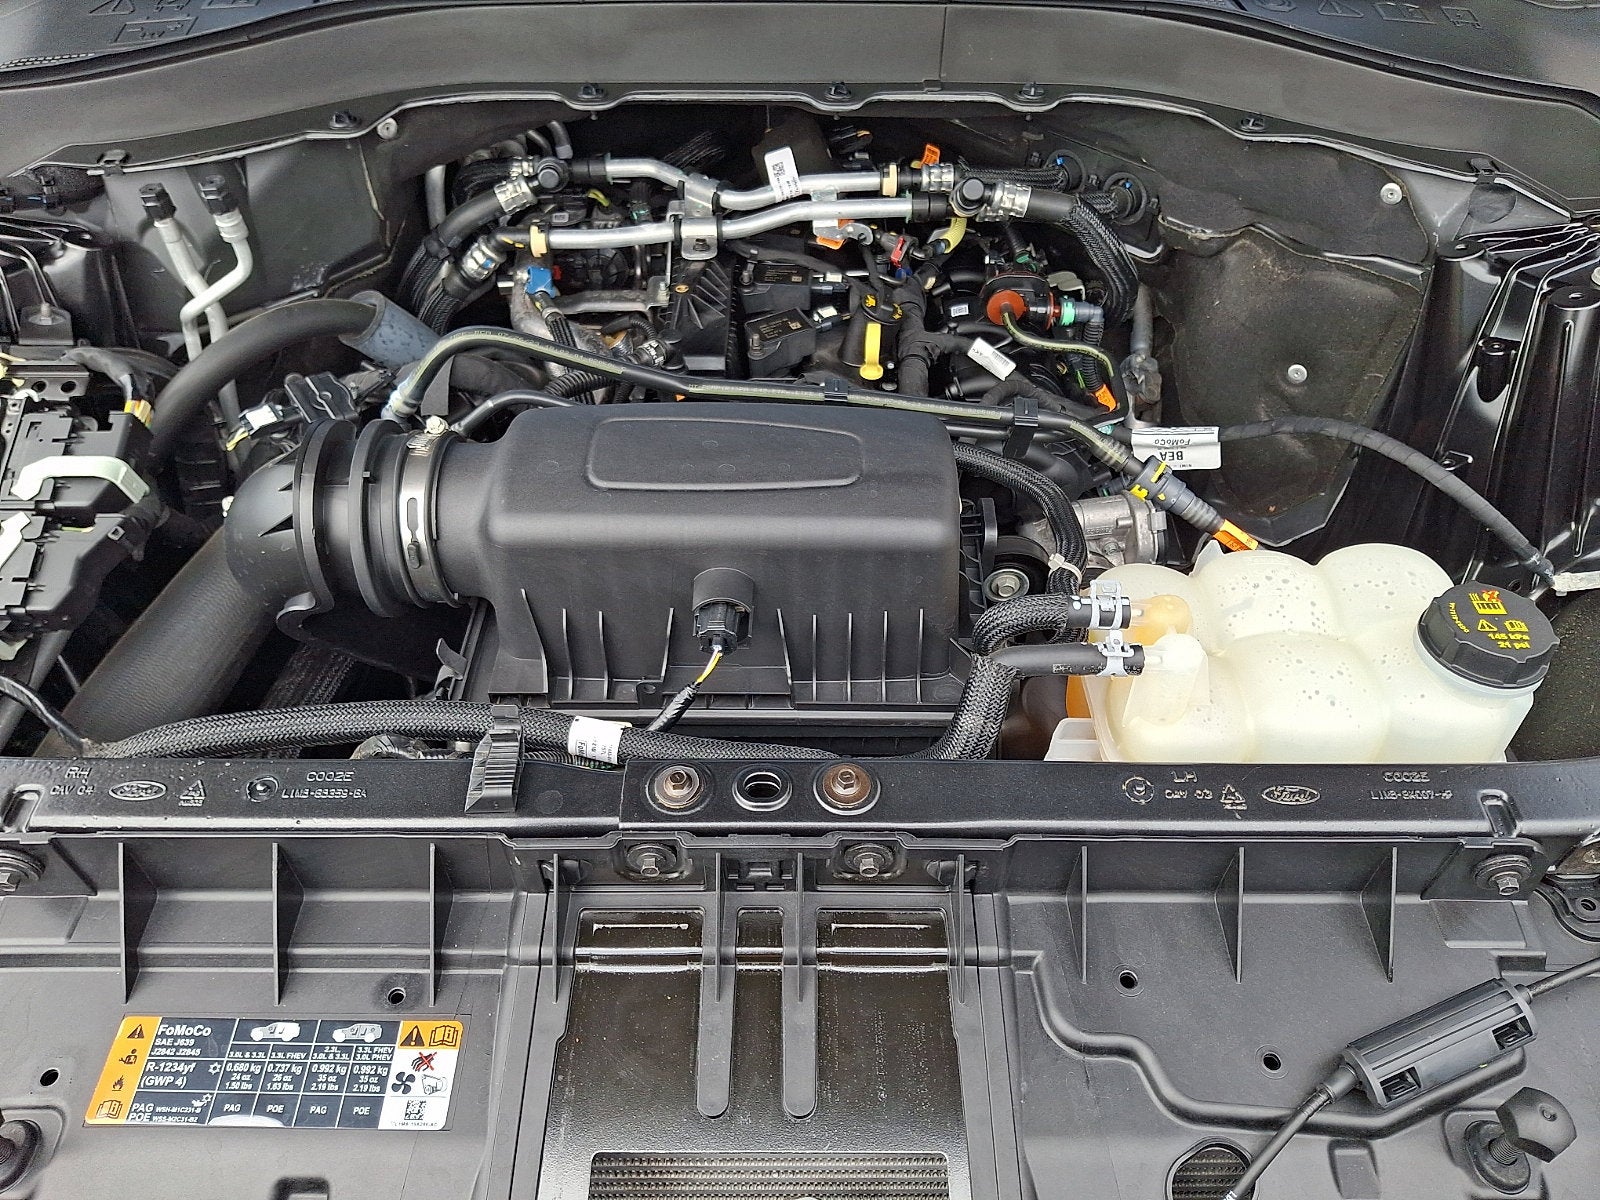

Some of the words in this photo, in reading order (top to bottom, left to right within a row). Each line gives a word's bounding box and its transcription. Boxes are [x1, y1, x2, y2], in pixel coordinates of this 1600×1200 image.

[1160, 450, 1184, 461] BEA
[65, 766, 92, 779] RH
[1171, 771, 1198, 783] LH
[1267, 786, 1316, 803] Ford
[157, 1024, 212, 1037] FoMoCo
[155, 1038, 173, 1046] SAE
[175, 1038, 195, 1046] J639
[373, 1046, 394, 1054] FHEV
[145, 1062, 197, 1074] R-1234yf
[226, 1062, 249, 1072] 0.680
[250, 1063, 262, 1075] kg
[267, 1063, 291, 1073] 0.737
[291, 1064, 303, 1075] kg
[311, 1063, 335, 1073] 0.992
[336, 1064, 348, 1076] kg
[353, 1065, 376, 1075] 0.992
[377, 1065, 389, 1077] kg
[231, 1073, 241, 1081] 24
[272, 1074, 282, 1082] 26
[317, 1074, 327, 1082] 35
[359, 1075, 368, 1083] 35
[140, 1076, 174, 1089] (GWP
[175, 1076, 188, 1089] 4)
[225, 1082, 241, 1090] 1.50
[241, 1082, 253, 1090] lbs
[266, 1082, 281, 1091] 1.63
[282, 1083, 294, 1091] lbs
[310, 1083, 327, 1091] 2.19
[327, 1083, 339, 1091] lbs
[353, 1084, 369, 1092] 2.19
[369, 1084, 381, 1092] lbs
[131, 1103, 155, 1113] PAG
[223, 1103, 241, 1112] PAG
[266, 1104, 285, 1113] POE
[309, 1105, 328, 1115] PAG
[353, 1106, 371, 1115] POE
[128, 1112, 152, 1122] POE
